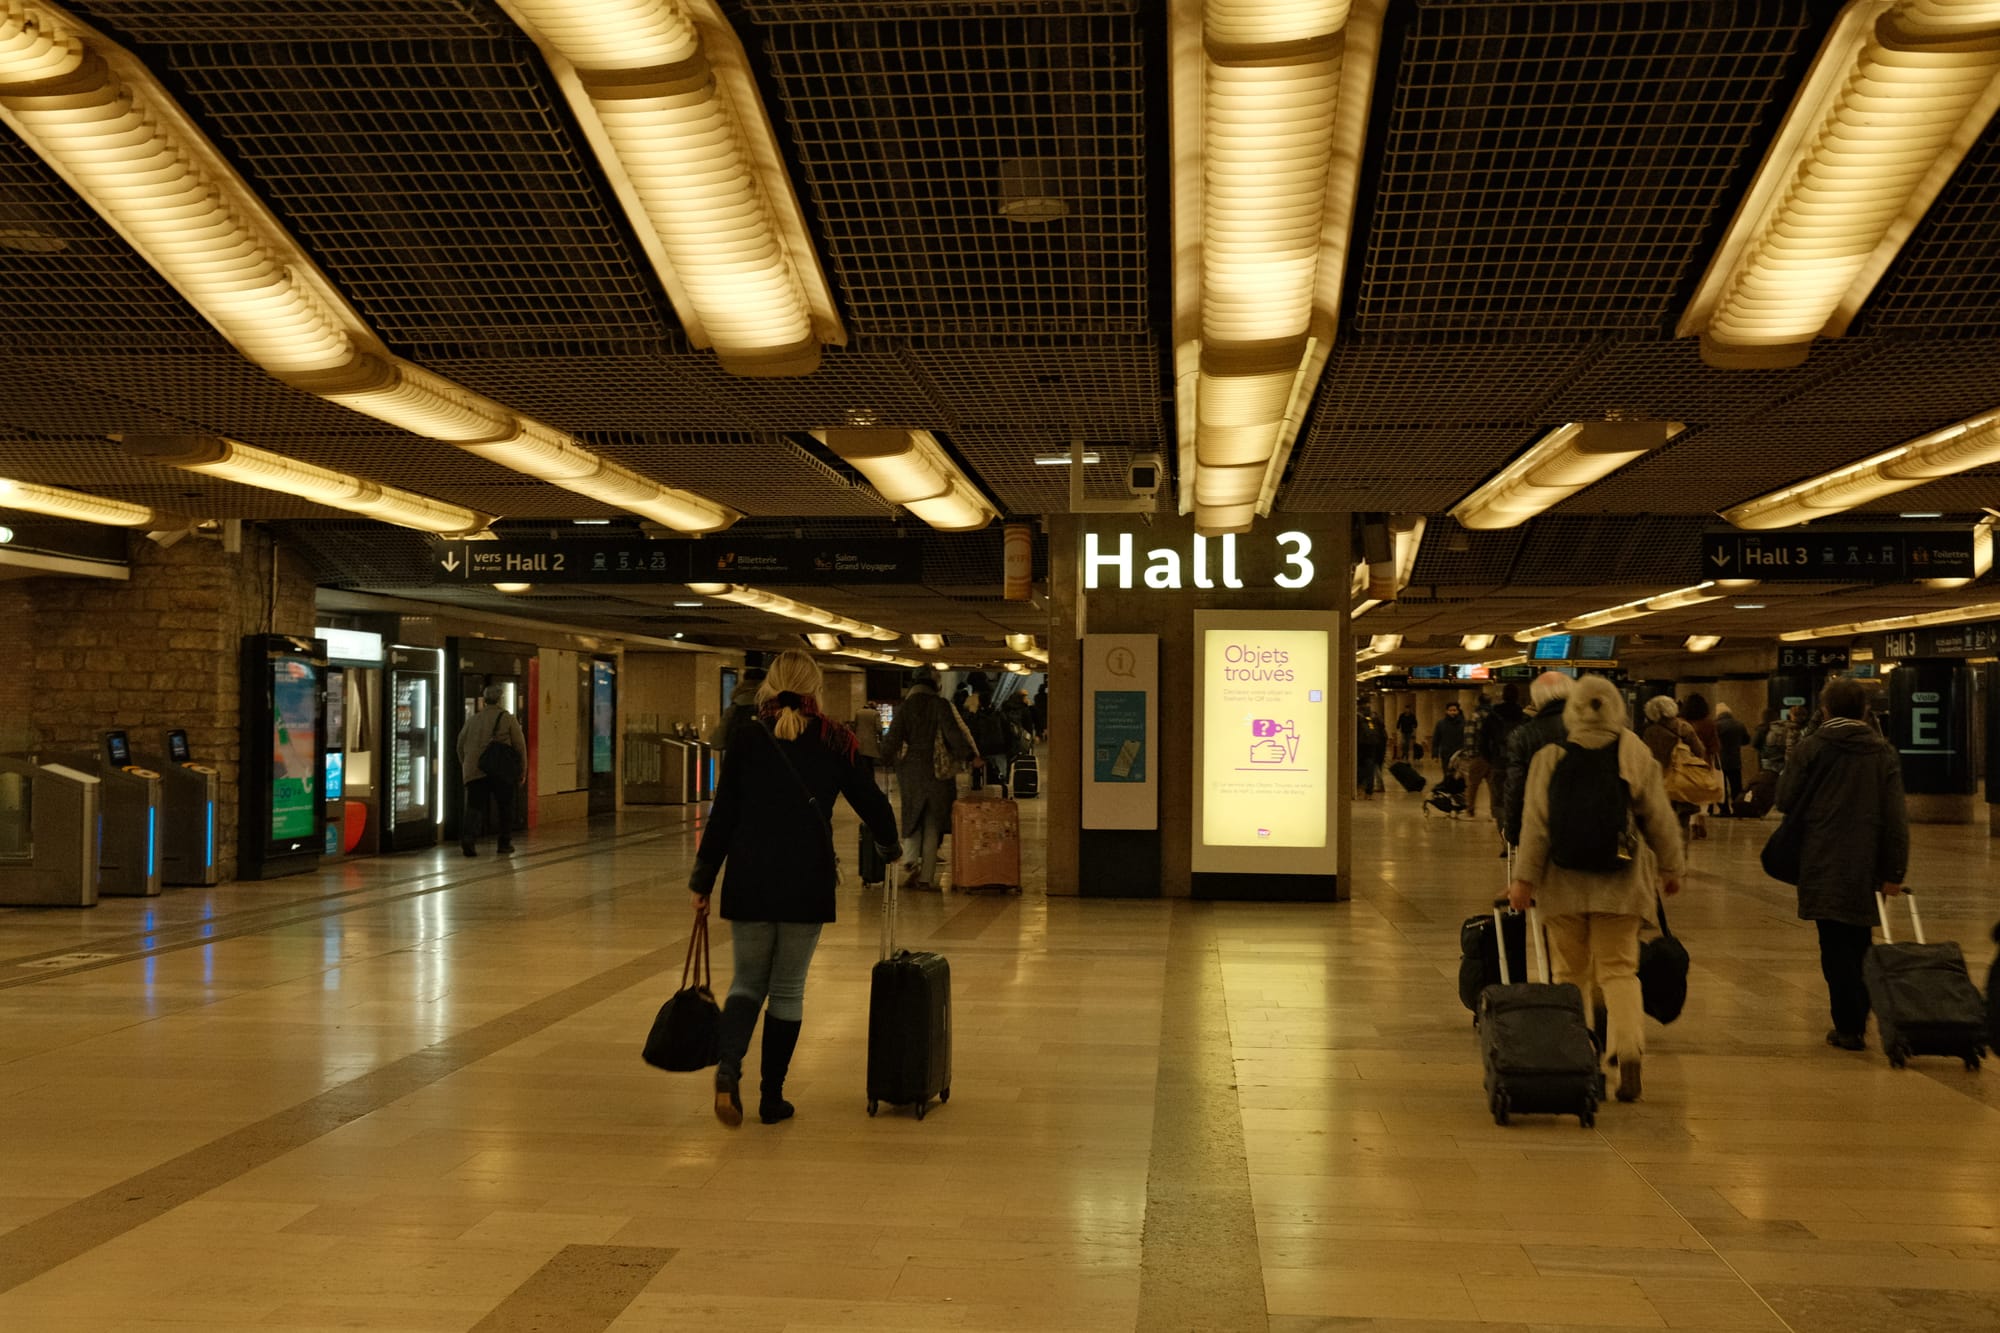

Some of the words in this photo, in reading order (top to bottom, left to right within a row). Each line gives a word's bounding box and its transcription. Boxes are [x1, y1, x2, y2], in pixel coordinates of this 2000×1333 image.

[474, 553, 502, 563] vers
[506, 553, 548, 571] Hall
[552, 553, 565, 571] 2
[619, 557, 629, 568] 5
[650, 557, 666, 568] 23
[835, 553, 858, 562] Salon
[1085, 533, 1244, 589] Hall
[1273, 531, 1314, 589] 3
[1745, 547, 1790, 565] Hall
[1795, 547, 1808, 565] 3
[1848, 551, 1859, 562] A
[1882, 551, 1893, 562] H
[835, 562, 860, 571] Grand
[860, 562, 897, 573] Voyageur
[1885, 632, 1907, 657] Hall
[1908, 631, 1916, 656] 3
[1224, 644, 1289, 668] Objets
[1807, 654, 1816, 665] E
[1224, 664, 1295, 682] trouvés
[1912, 707, 1940, 745] E
